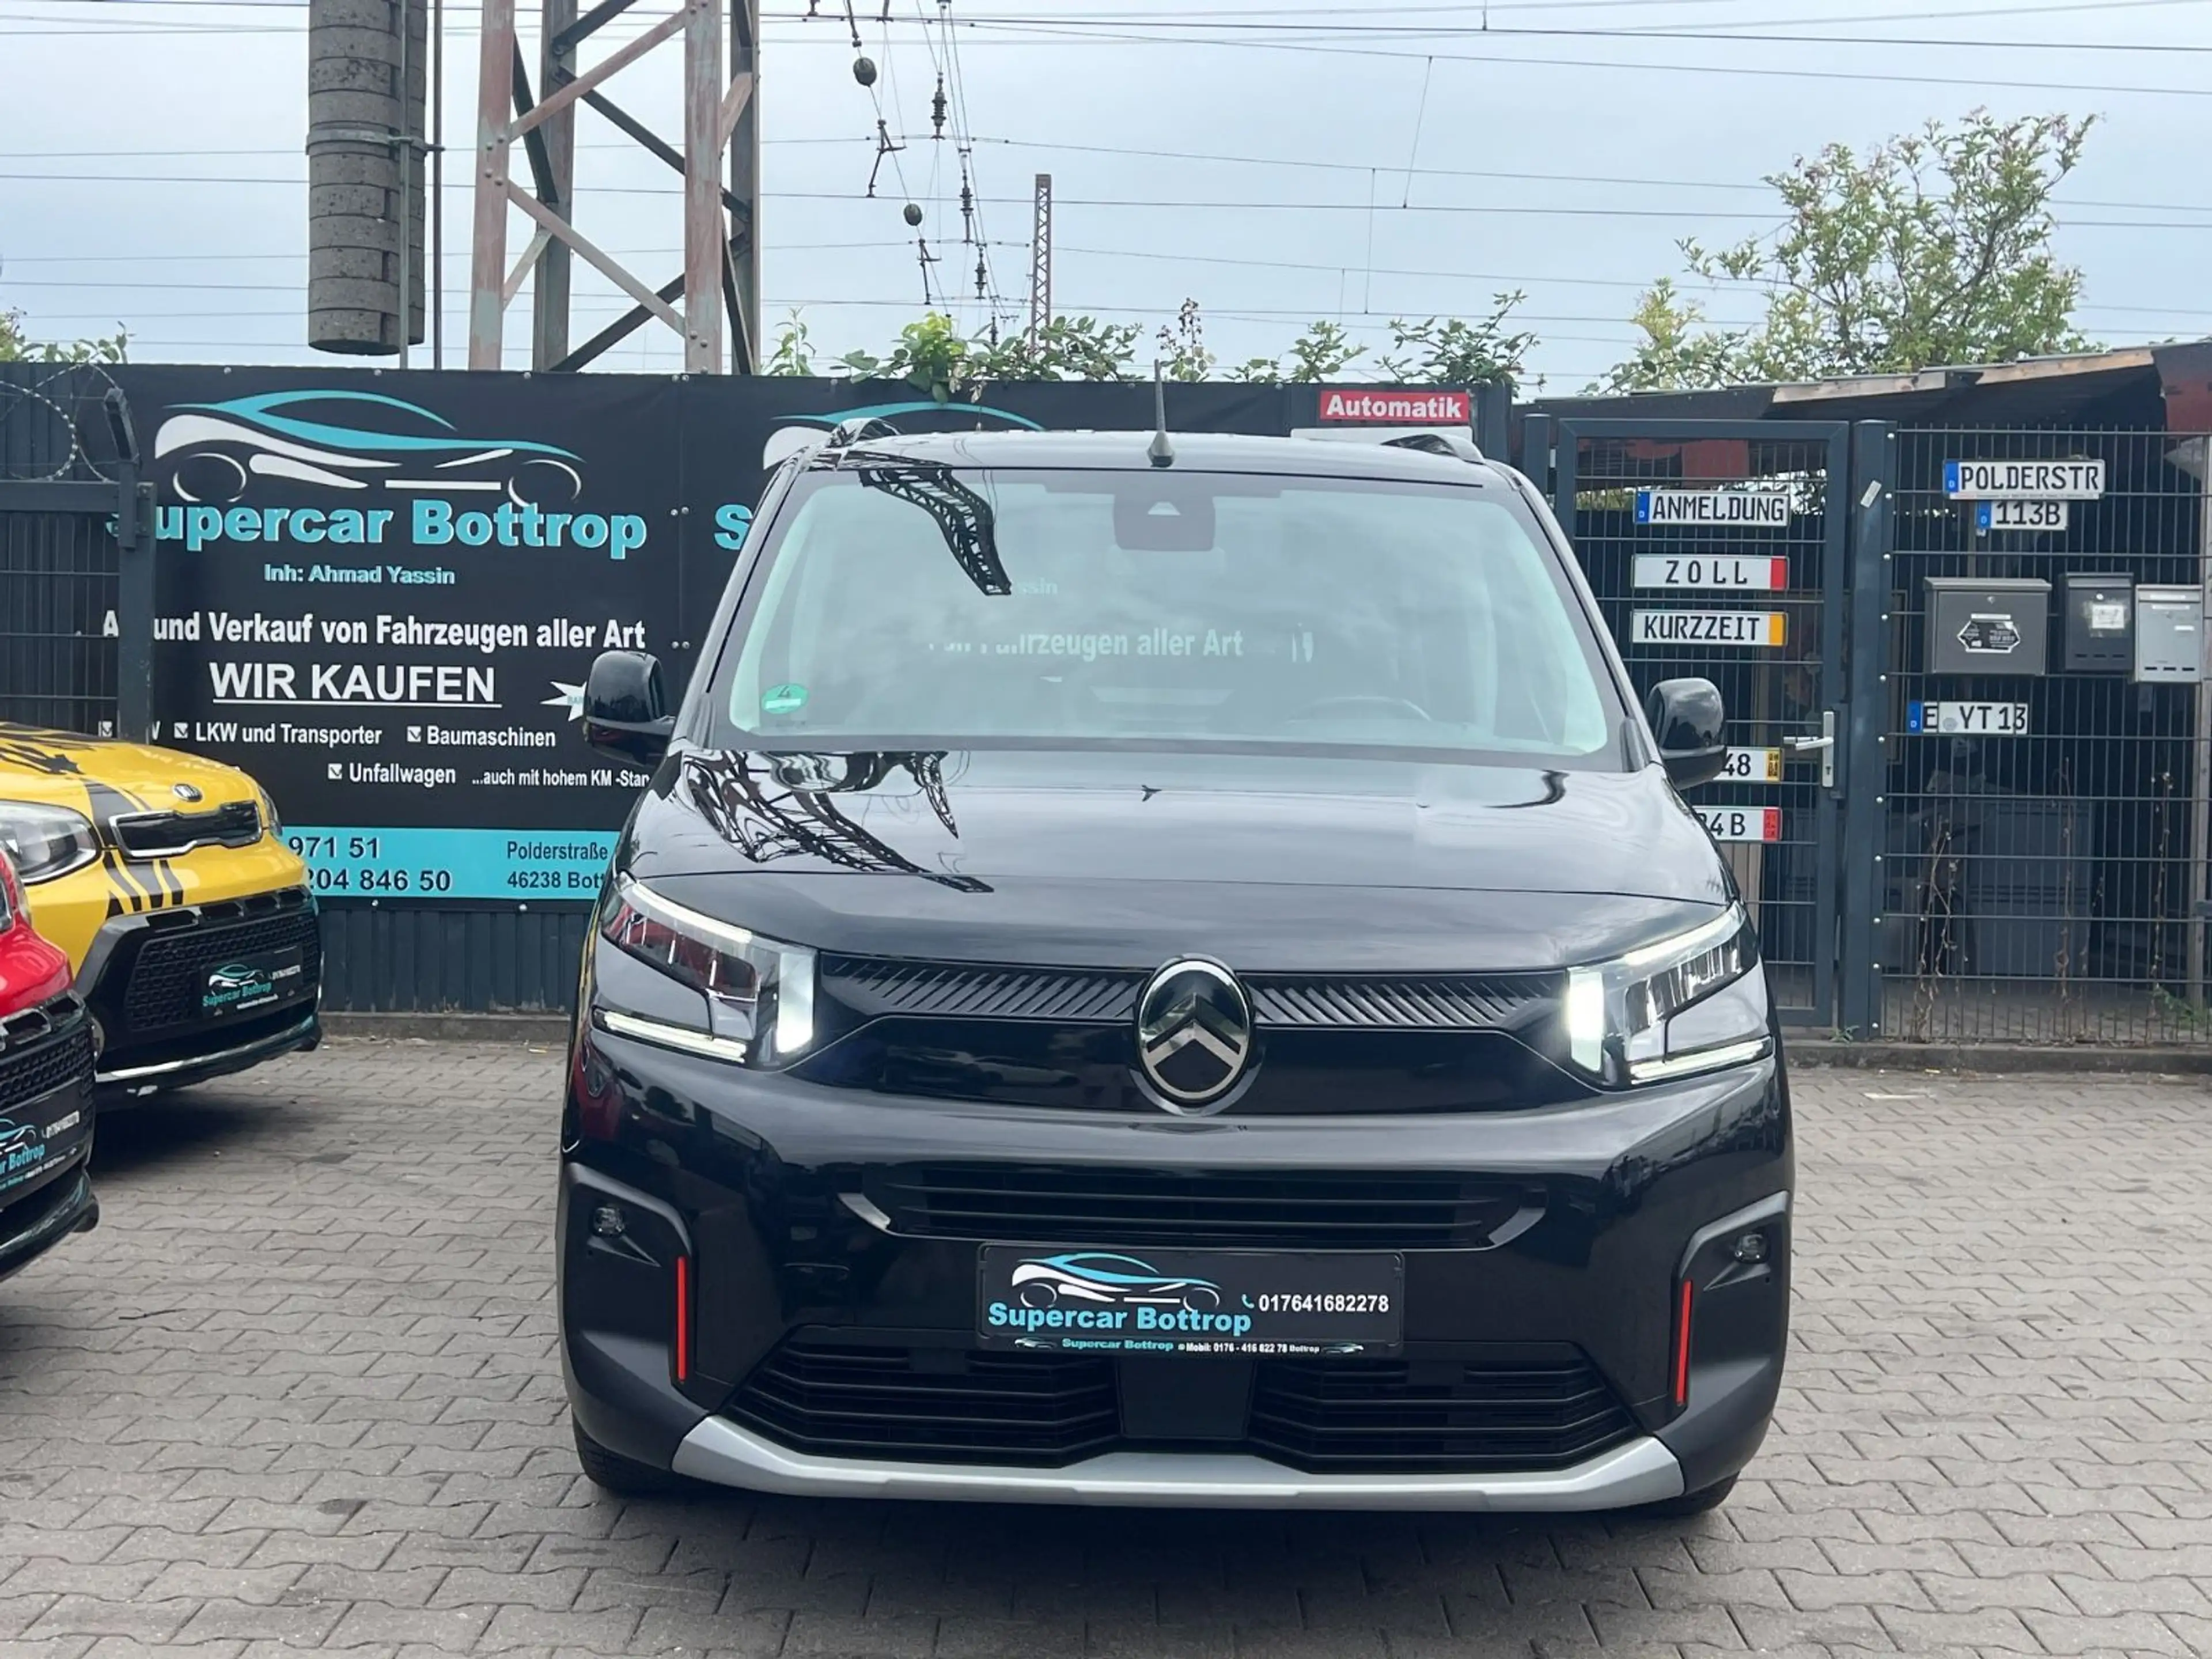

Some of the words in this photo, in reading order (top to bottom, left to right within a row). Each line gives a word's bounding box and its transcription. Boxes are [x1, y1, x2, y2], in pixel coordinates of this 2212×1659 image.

[1327, 395, 1461, 418] Automatik
[1960, 465, 2099, 490] POLDERSTR
[1653, 495, 1785, 521] ANMELDUNG
[1995, 501, 2061, 525] 113B
[106, 506, 394, 551] upercar
[412, 499, 647, 559] Bottrop
[264, 564, 303, 582] Inh:
[308, 565, 382, 584] Ahmad
[386, 566, 455, 584] Yassin
[153, 611, 200, 641] und
[209, 612, 313, 642] Verkauf
[321, 621, 368, 643] von
[376, 615, 528, 653] Fahrzeugen
[537, 618, 597, 647] aller
[603, 619, 646, 649] Art
[1644, 615, 1759, 641] KURZZEIT
[1137, 628, 1195, 657] aller
[1203, 628, 1243, 657] Art
[209, 662, 297, 699] WIR
[312, 664, 495, 702] KAUFEN
[196, 722, 237, 742] LKW
[243, 723, 275, 743] und
[281, 724, 382, 748] Transporter
[427, 725, 556, 747] Baumaschinen
[349, 762, 456, 787] Unfallwagen
[518, 768, 540, 786] mit
[543, 769, 587, 786] hohem
[591, 770, 612, 786] KM
[1730, 812, 1745, 836] B
[289, 836, 337, 858] 971
[349, 837, 380, 858] 51
[507, 840, 608, 860] Polderstraße
[359, 869, 409, 891] 846
[419, 870, 452, 891] 50
[507, 870, 561, 888] 46238
[9, 1143, 45, 1171] Bottrop
[988, 1302, 1128, 1332] Supercar
[1138, 1306, 1251, 1336] Bottrop
[1259, 1294, 1389, 1312] 017641682278
[1062, 1338, 1122, 1350] Supercar
[1124, 1339, 1174, 1351] Bottrop
[1213, 1342, 1234, 1353] 0176
